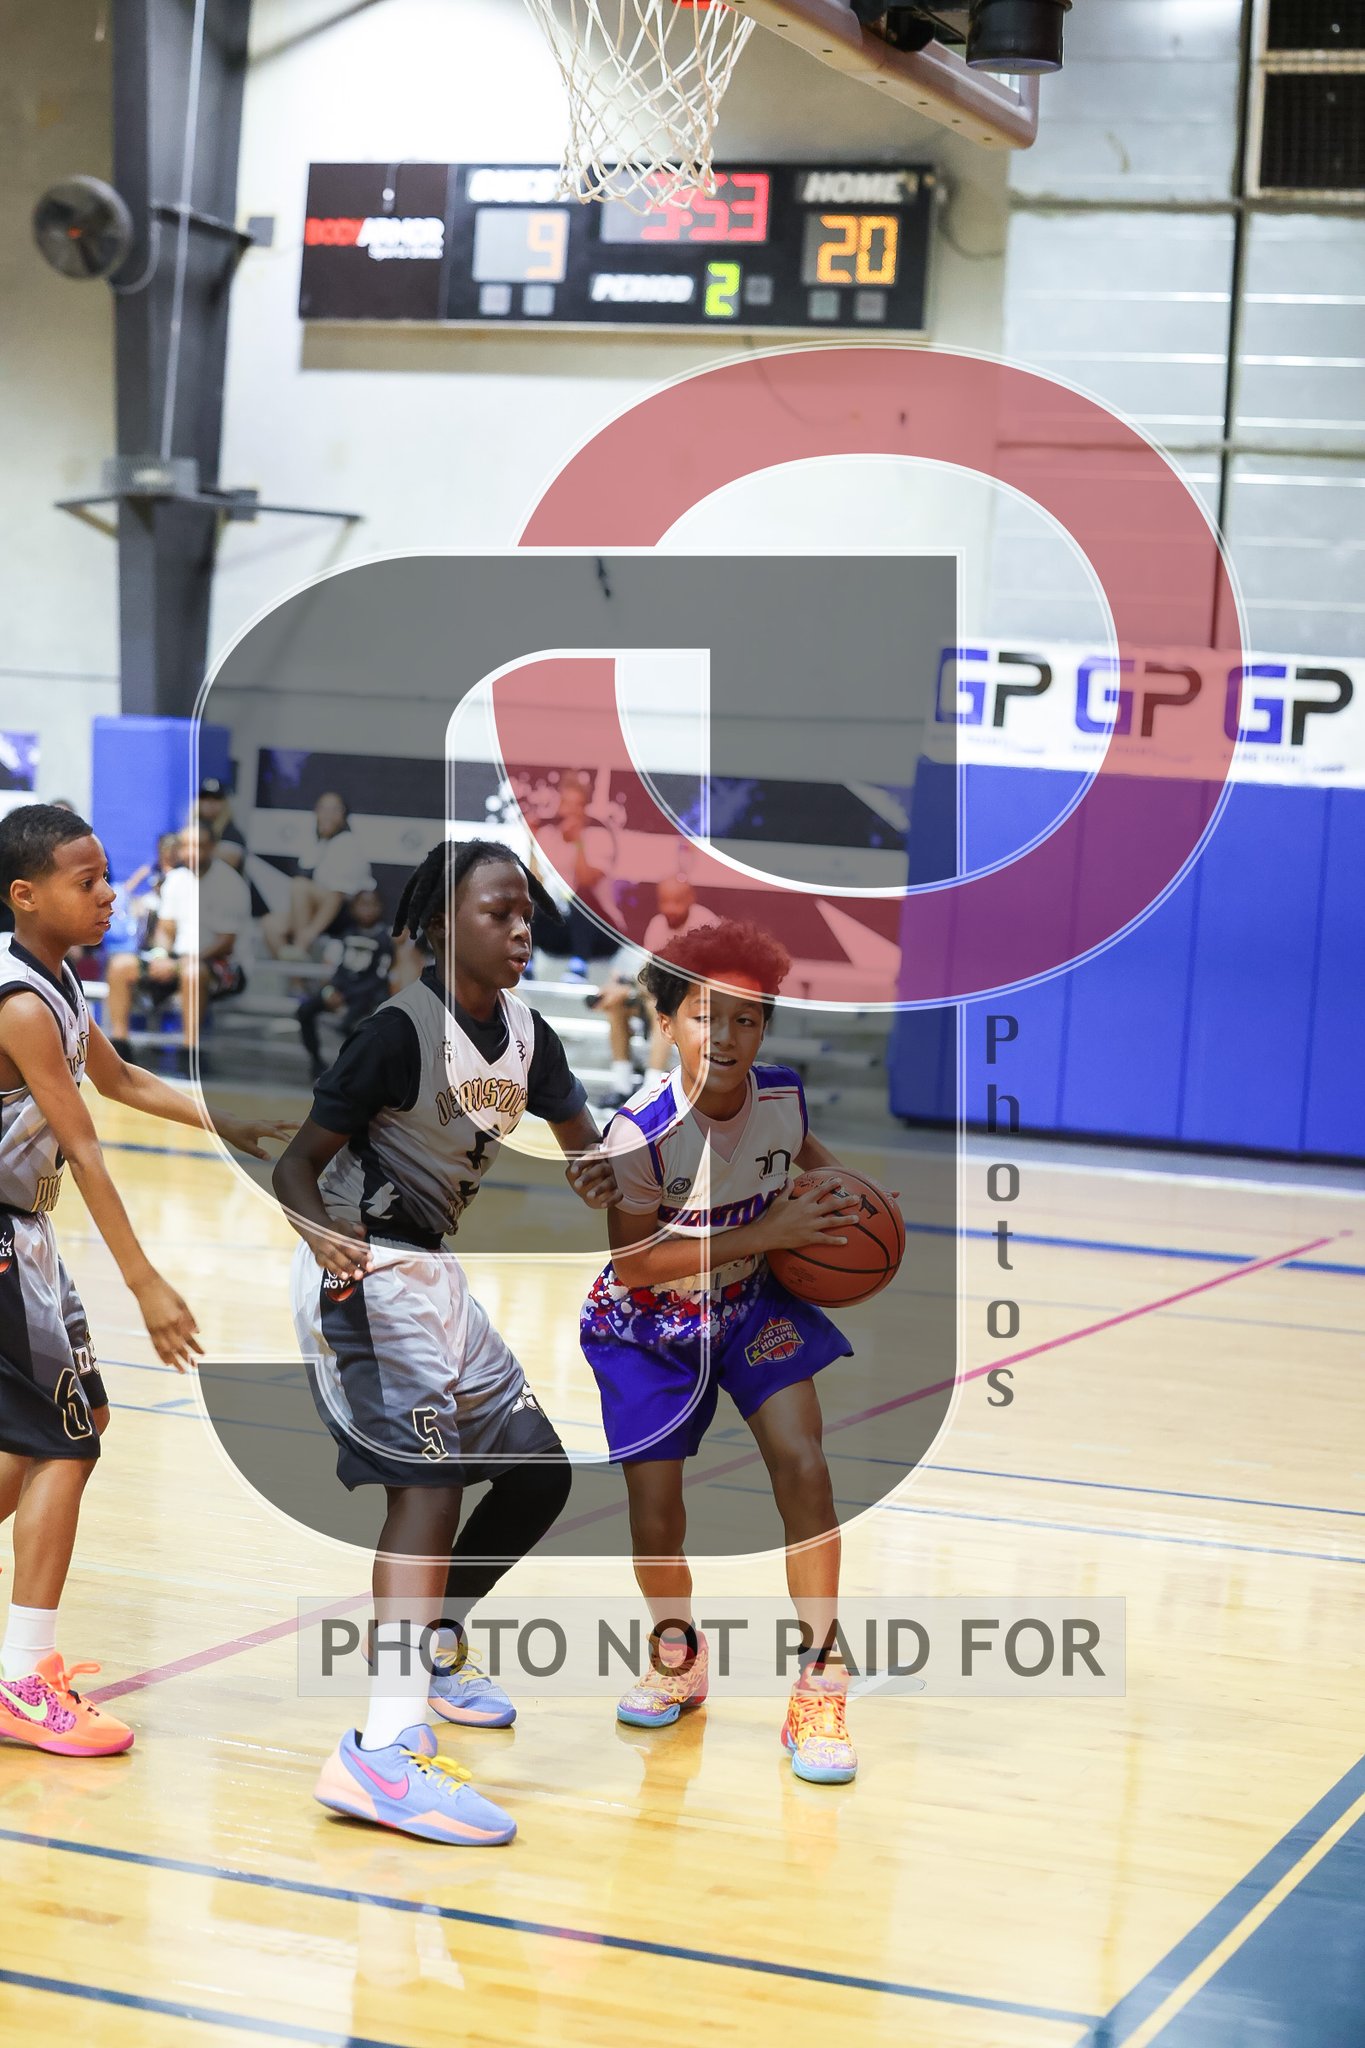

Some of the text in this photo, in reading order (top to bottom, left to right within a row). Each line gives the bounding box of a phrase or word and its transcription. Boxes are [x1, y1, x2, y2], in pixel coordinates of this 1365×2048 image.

[803, 172, 903, 203] HOME
[525, 212, 567, 281] 9
[816, 215, 898, 285] 20
[704, 262, 740, 317] 2
[935, 647, 1052, 728] GP
[1074, 655, 1202, 738] GP
[1222, 664, 1354, 746] GP
[435, 1077, 528, 1127] DEADSTOC
[54, 1367, 93, 1440] 6
[412, 1406, 449, 1462] 5
